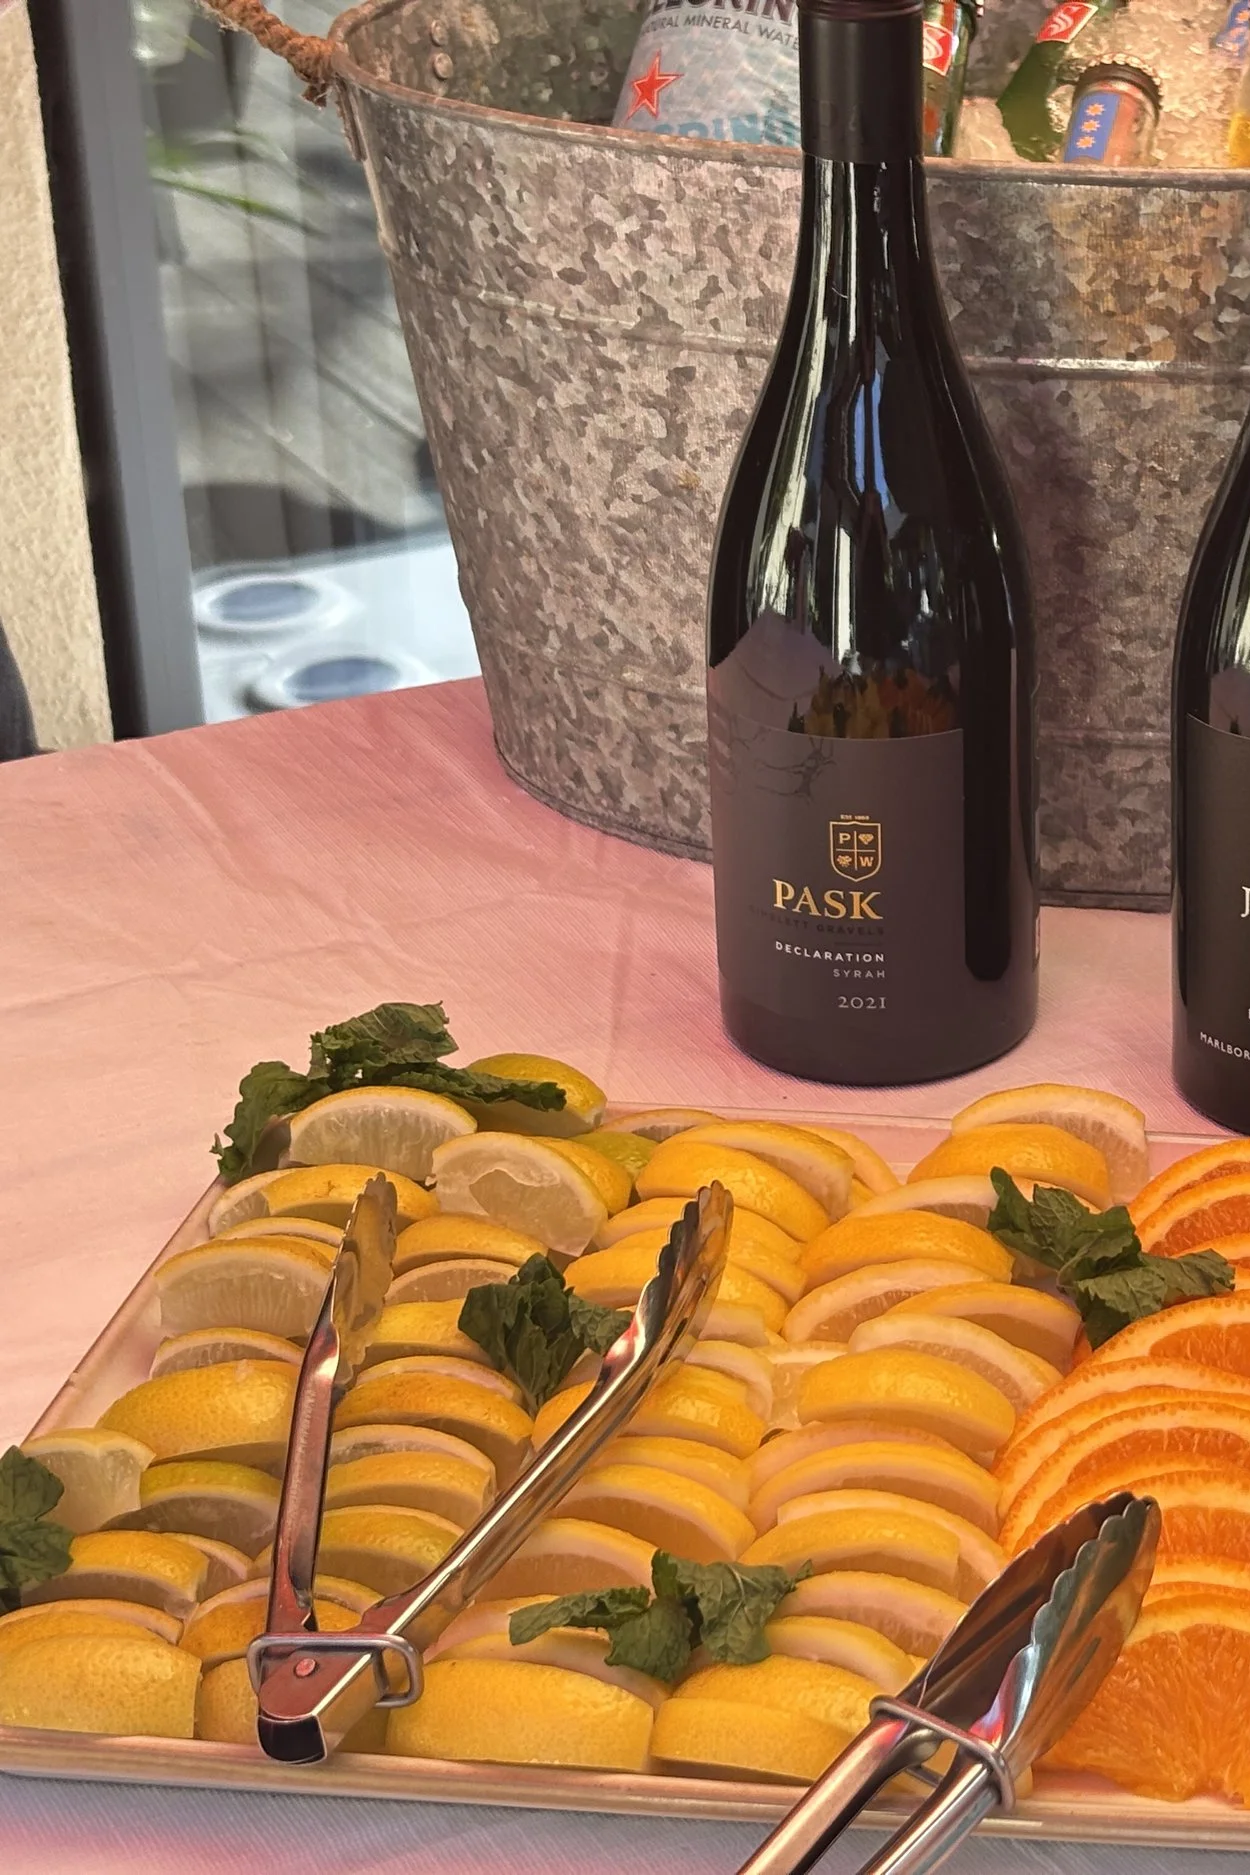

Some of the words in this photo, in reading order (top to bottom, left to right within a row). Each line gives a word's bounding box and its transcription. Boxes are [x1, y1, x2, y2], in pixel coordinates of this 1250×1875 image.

[684, 15, 750, 34] MINERAL
[839, 832, 851, 844] P
[859, 856, 874, 868] W
[773, 879, 884, 920] PASK
[775, 941, 885, 963] DECLARATION
[833, 968, 886, 979] SYRAH
[838, 996, 887, 1009] 2021
